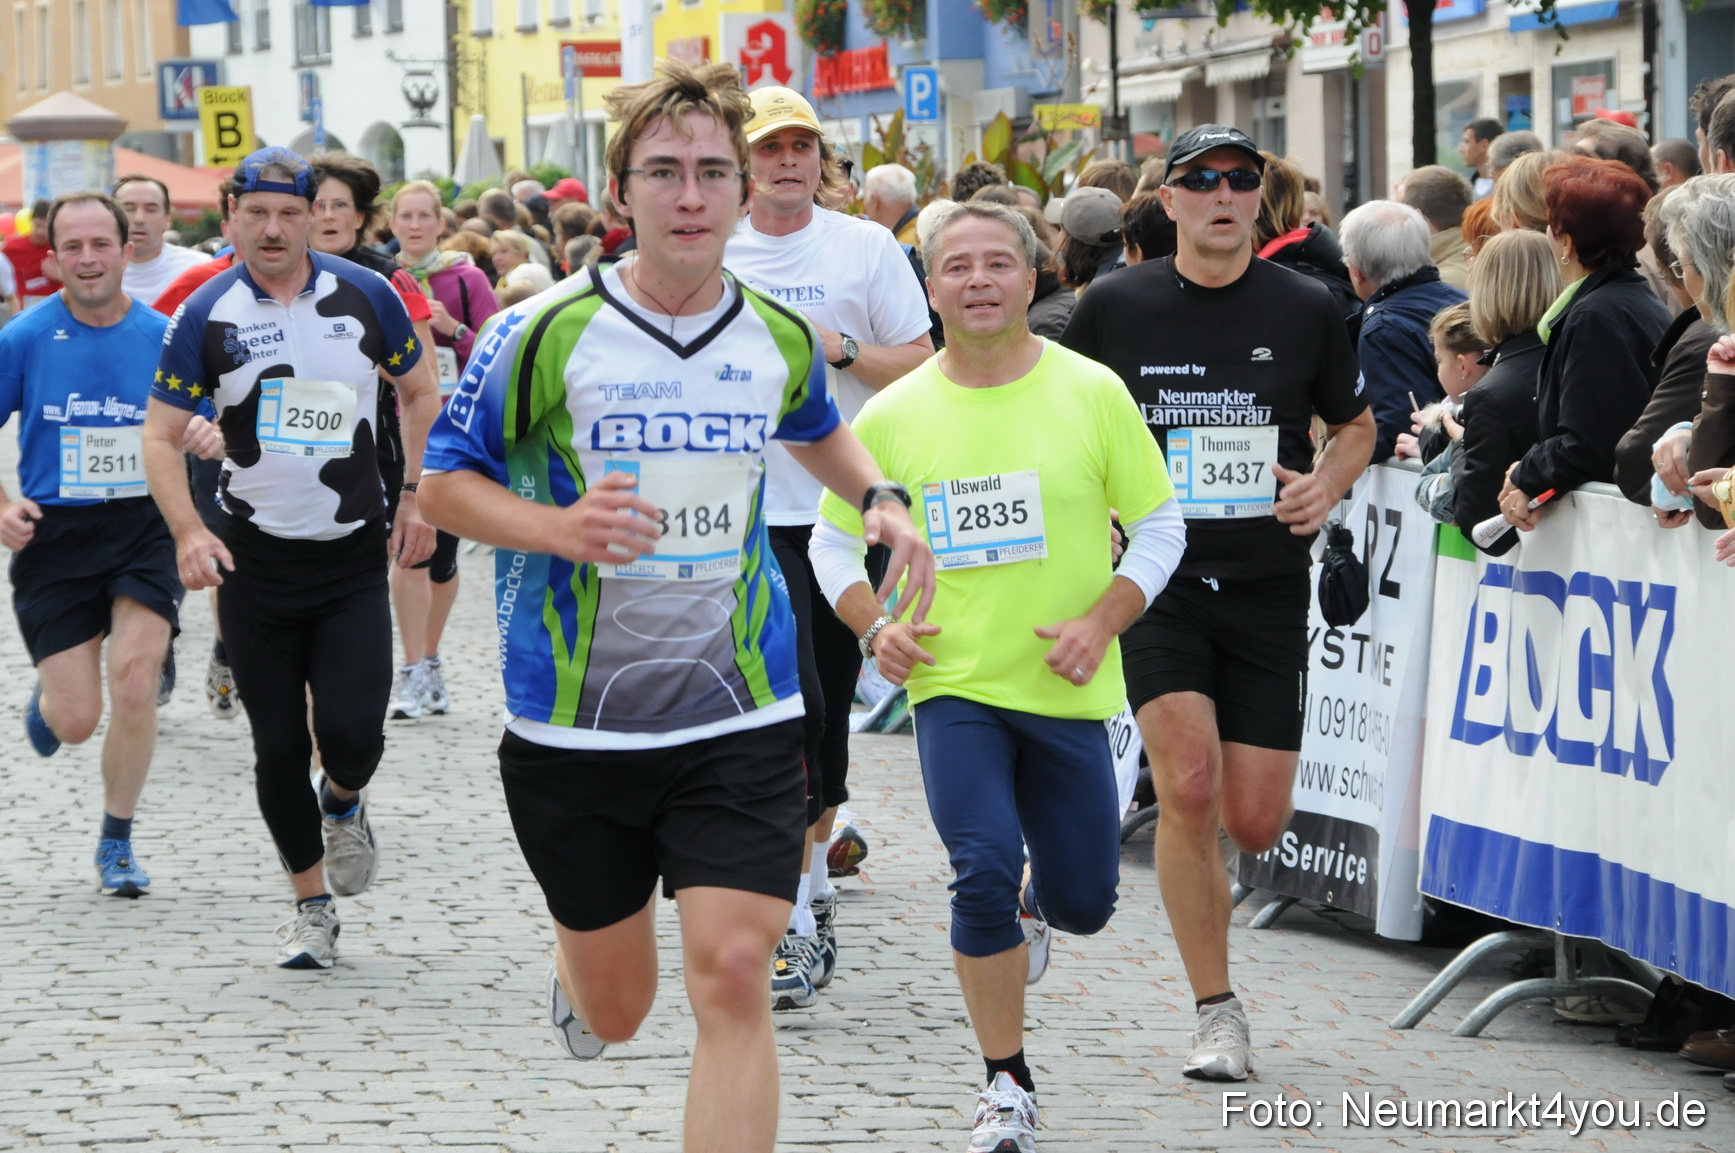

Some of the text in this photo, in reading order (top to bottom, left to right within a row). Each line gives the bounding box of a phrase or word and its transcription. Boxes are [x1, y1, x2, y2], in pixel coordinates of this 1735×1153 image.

[204, 89, 246, 104] Block
[911, 73, 931, 117] P
[214, 112, 242, 149] B
[765, 285, 825, 302] RTEIS
[225, 321, 277, 337] Franken
[223, 329, 285, 354] Speed
[233, 348, 278, 364] Fighter
[447, 309, 526, 434] BOCK
[1140, 364, 1206, 377] powered by
[599, 382, 682, 401] TEAM
[1158, 389, 1256, 405] Neumarkter
[285, 407, 342, 431] 2500
[1140, 403, 1272, 426] Lammsbräu
[86, 435, 116, 448] Peter
[591, 413, 768, 453] BOCK
[1200, 436, 1251, 452] Thomas
[67, 454, 72, 463] A
[88, 453, 137, 474] 2511
[1176, 461, 1182, 473] B
[1202, 461, 1265, 485] 3437
[658, 503, 732, 538] 3184
[931, 508, 939, 522] C
[956, 499, 1028, 532] 2835
[999, 542, 1045, 557] PFLEIDERER
[695, 557, 738, 573] PFLEIDERER
[1450, 563, 1677, 787] BOCK
[1256, 831, 1367, 885] -Service
